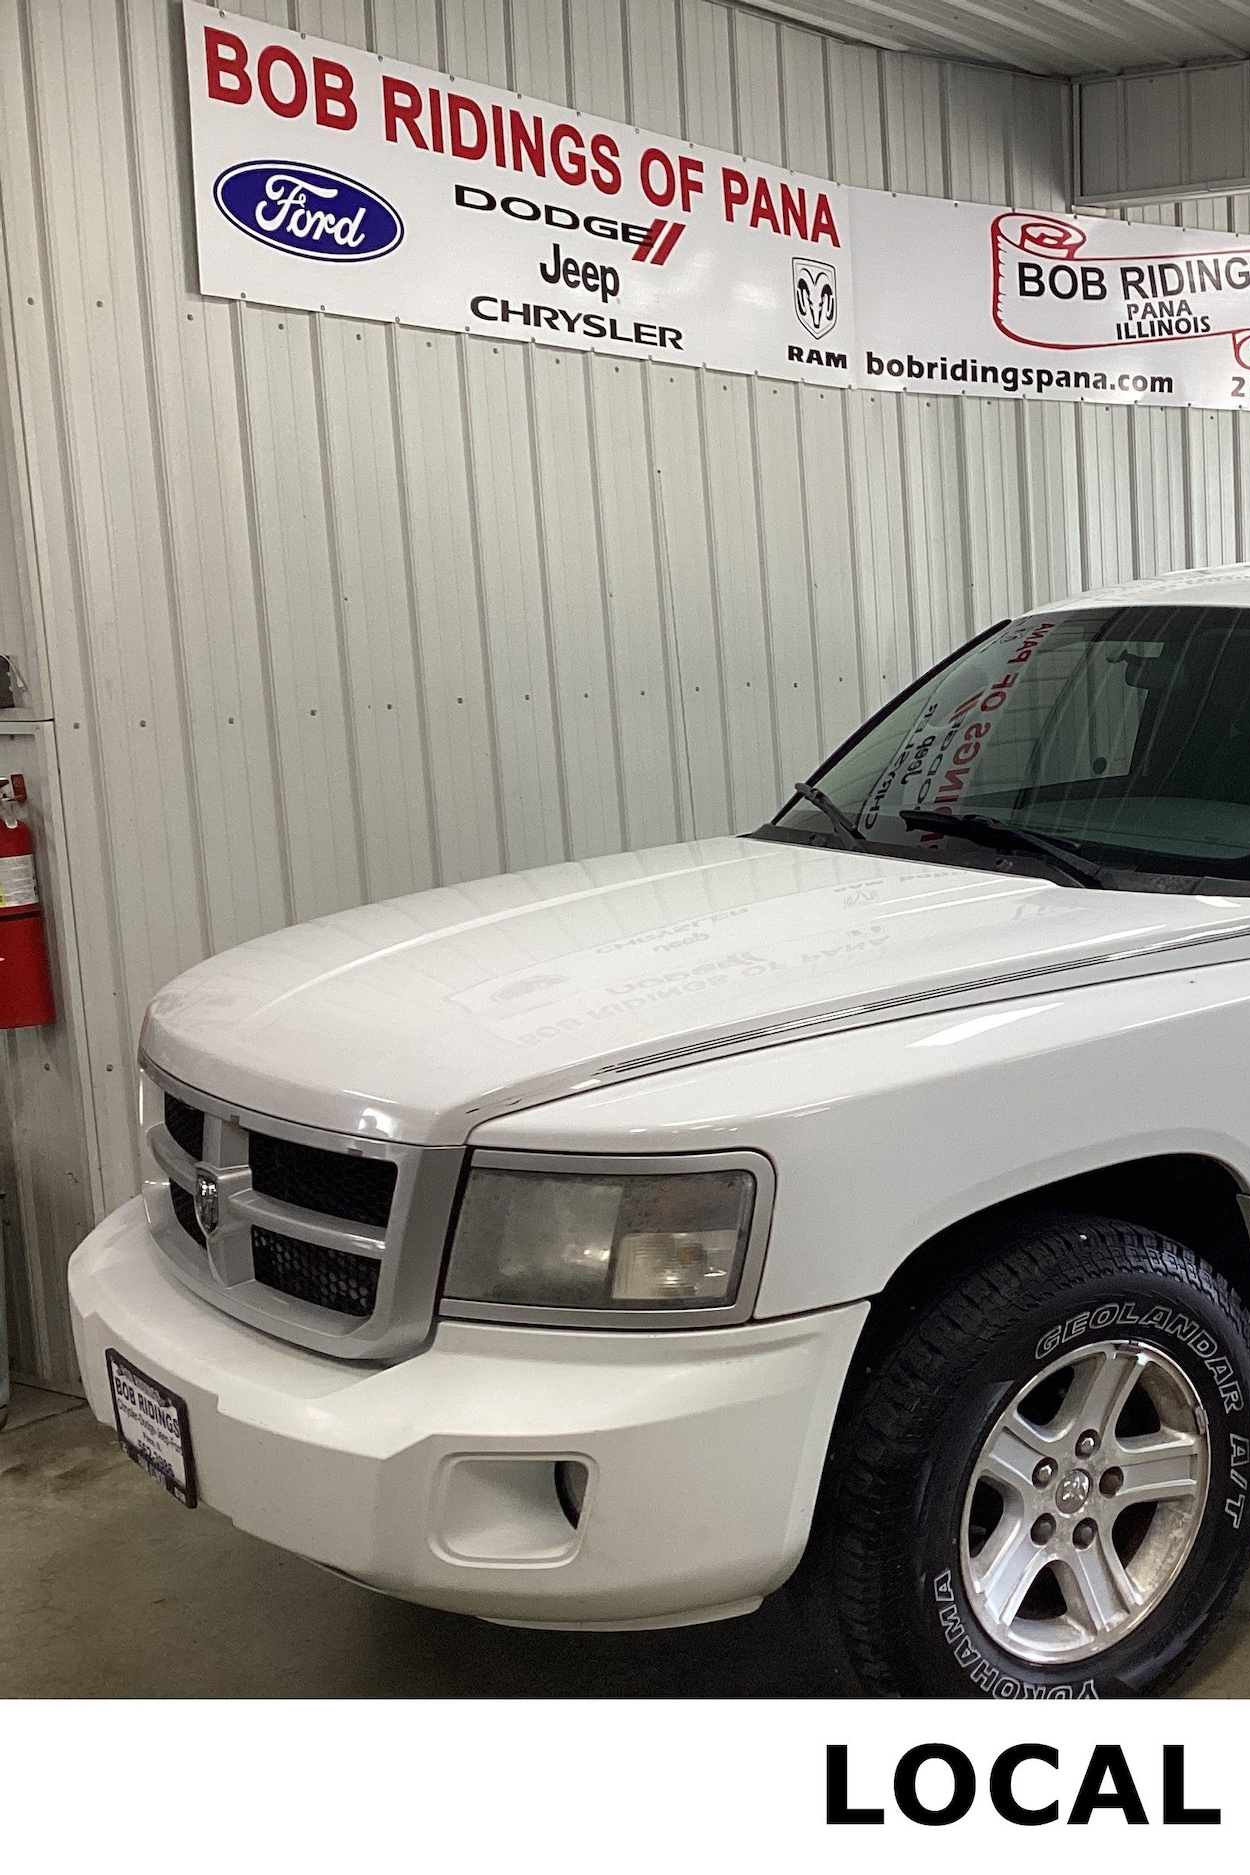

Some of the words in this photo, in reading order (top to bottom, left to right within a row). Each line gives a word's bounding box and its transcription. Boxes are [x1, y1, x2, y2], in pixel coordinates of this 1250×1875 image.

[204, 26, 358, 131] BOB
[382, 75, 622, 195] RIDINGS
[639, 147, 704, 213] OF
[721, 167, 840, 248] PANA
[255, 174, 366, 247] Ford
[454, 184, 656, 247] DODGE
[539, 243, 620, 303] Jeep
[1018, 262, 1107, 300] BOB
[469, 295, 684, 351] CHRYSLER
[1116, 316, 1211, 340] ILLINOIS
[1126, 299, 1193, 321] PANA
[787, 345, 848, 369] RAM
[866, 351, 1174, 395] bobridingspana.com
[115, 1376, 136, 1406] BOB
[138, 1391, 180, 1439] RIDINGS
[1035, 1302, 1245, 1415] GEOLANDAR
[1224, 1433, 1250, 1529] A/T
